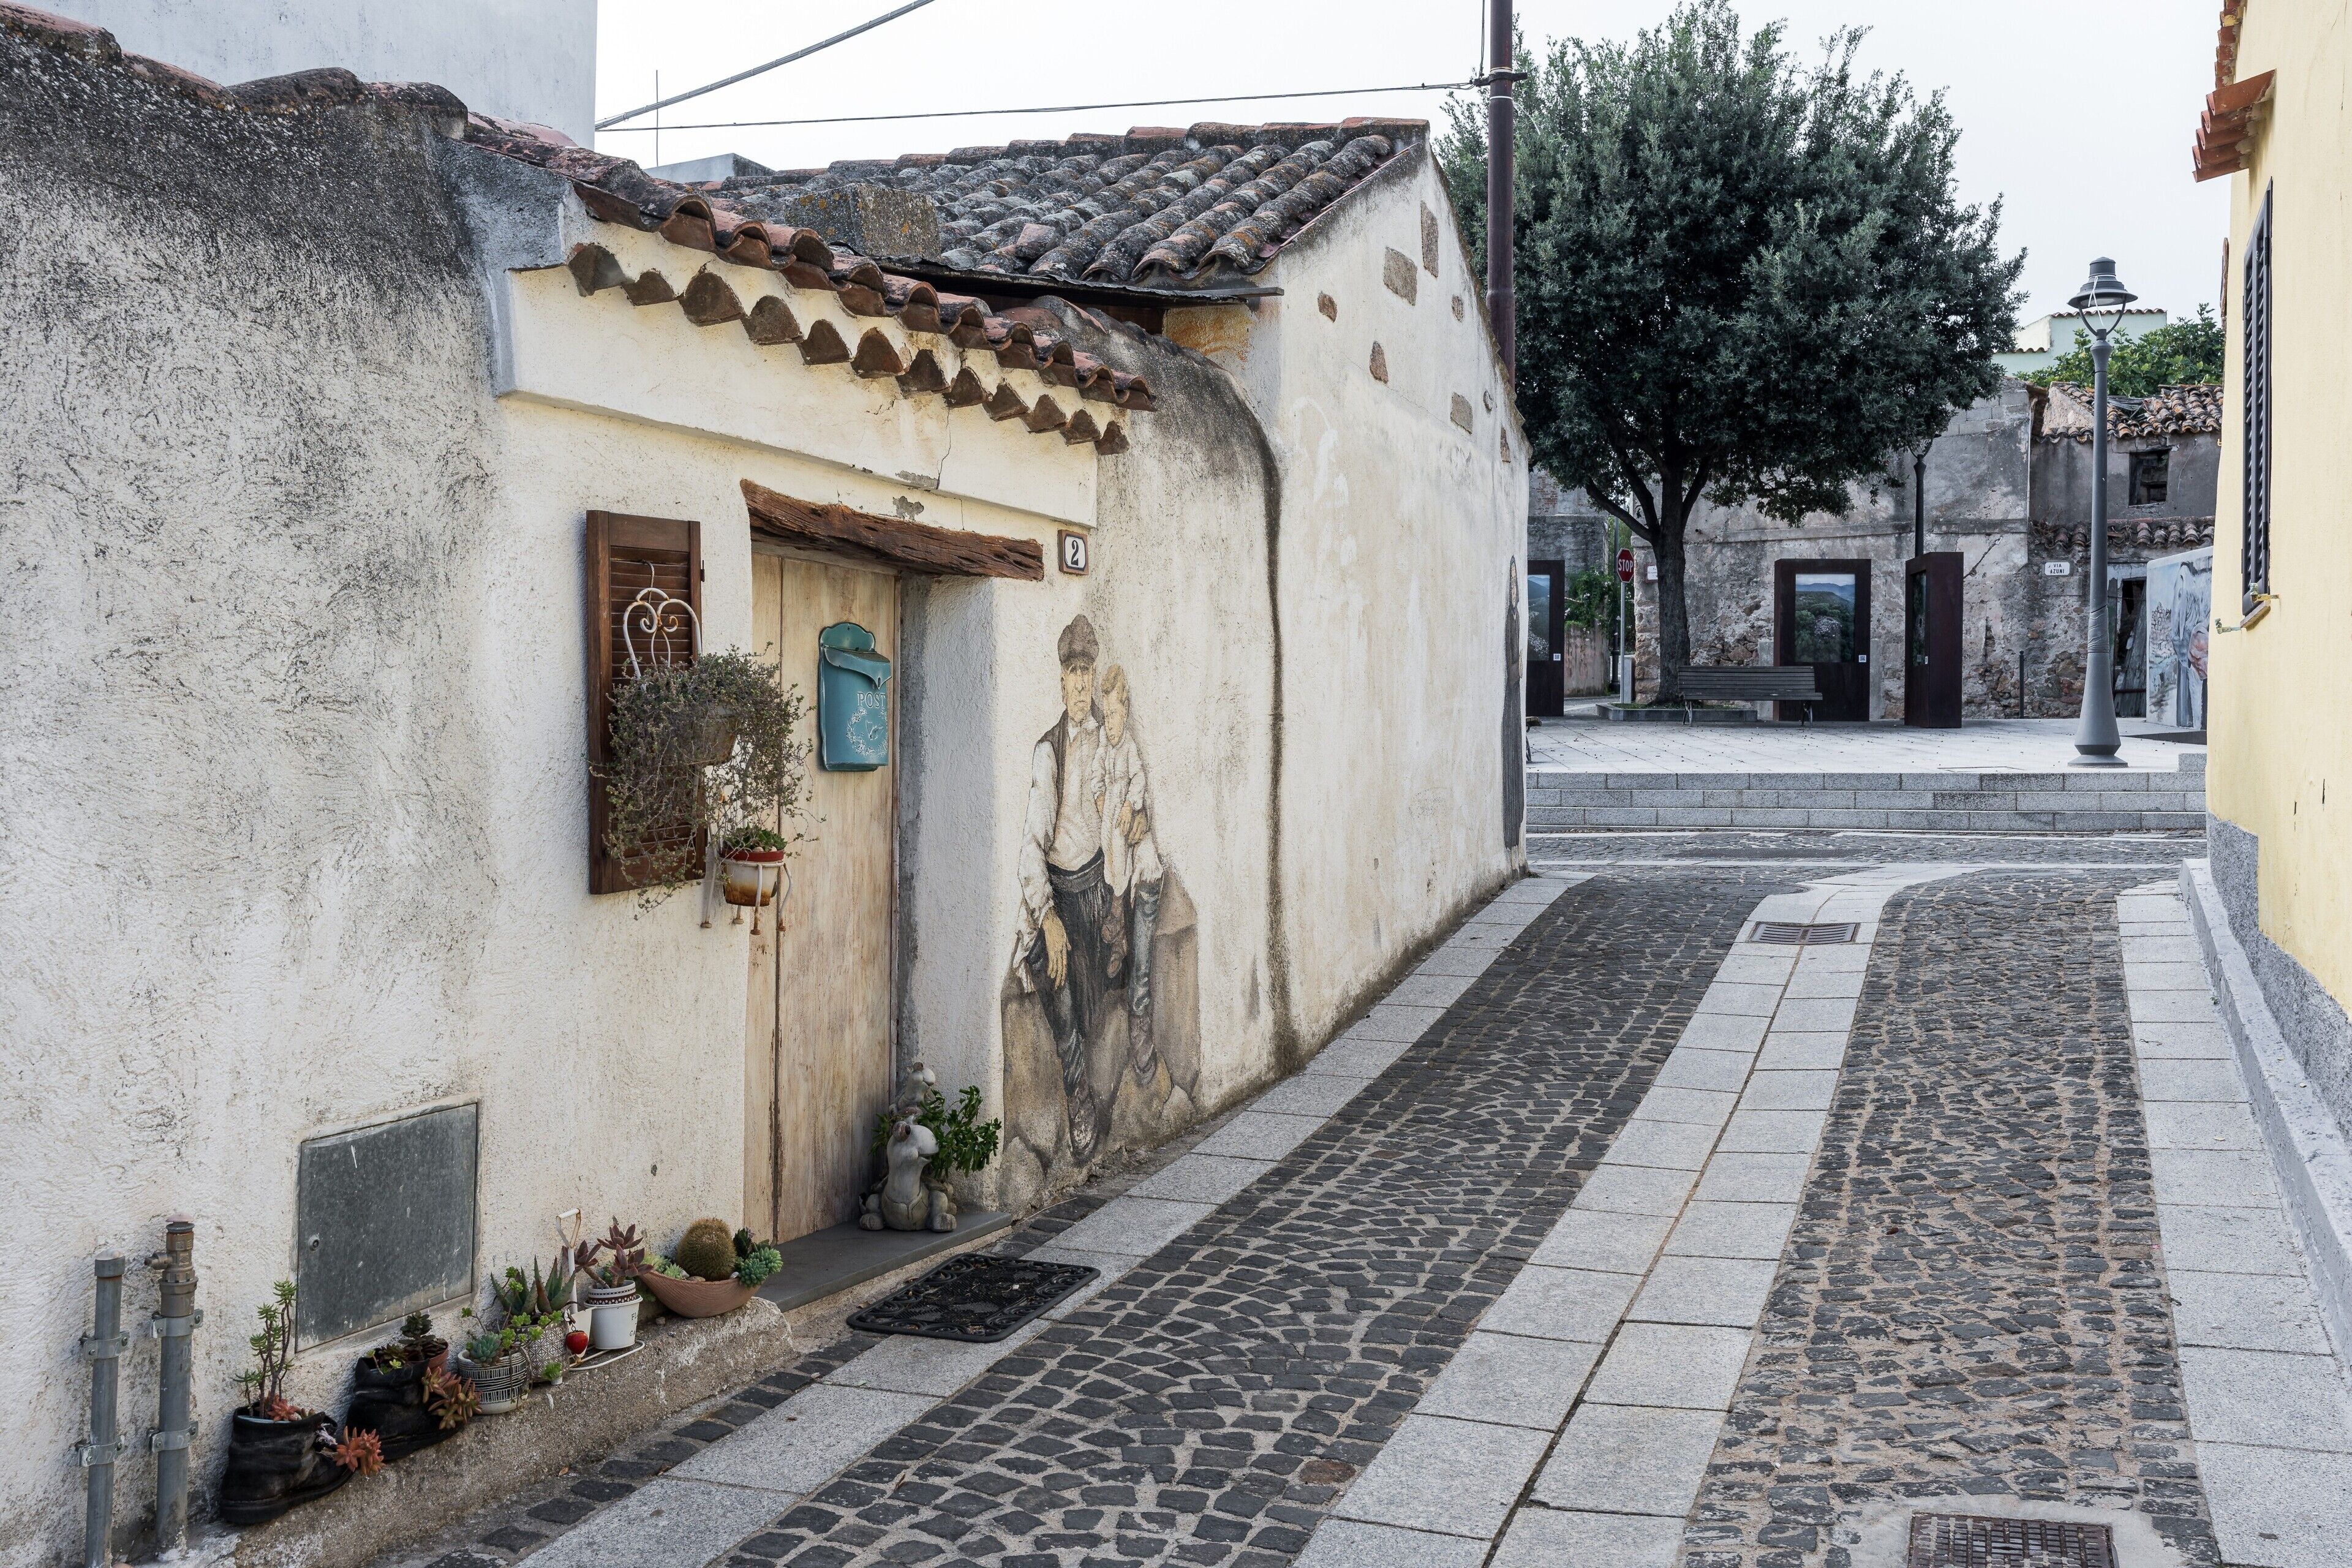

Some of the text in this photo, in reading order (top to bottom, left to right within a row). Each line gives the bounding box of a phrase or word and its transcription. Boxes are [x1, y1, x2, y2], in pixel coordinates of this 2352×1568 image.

[1071, 540, 1079, 566] 2
[1618, 559, 1634, 573] STOP
[858, 692, 886, 709] POST
